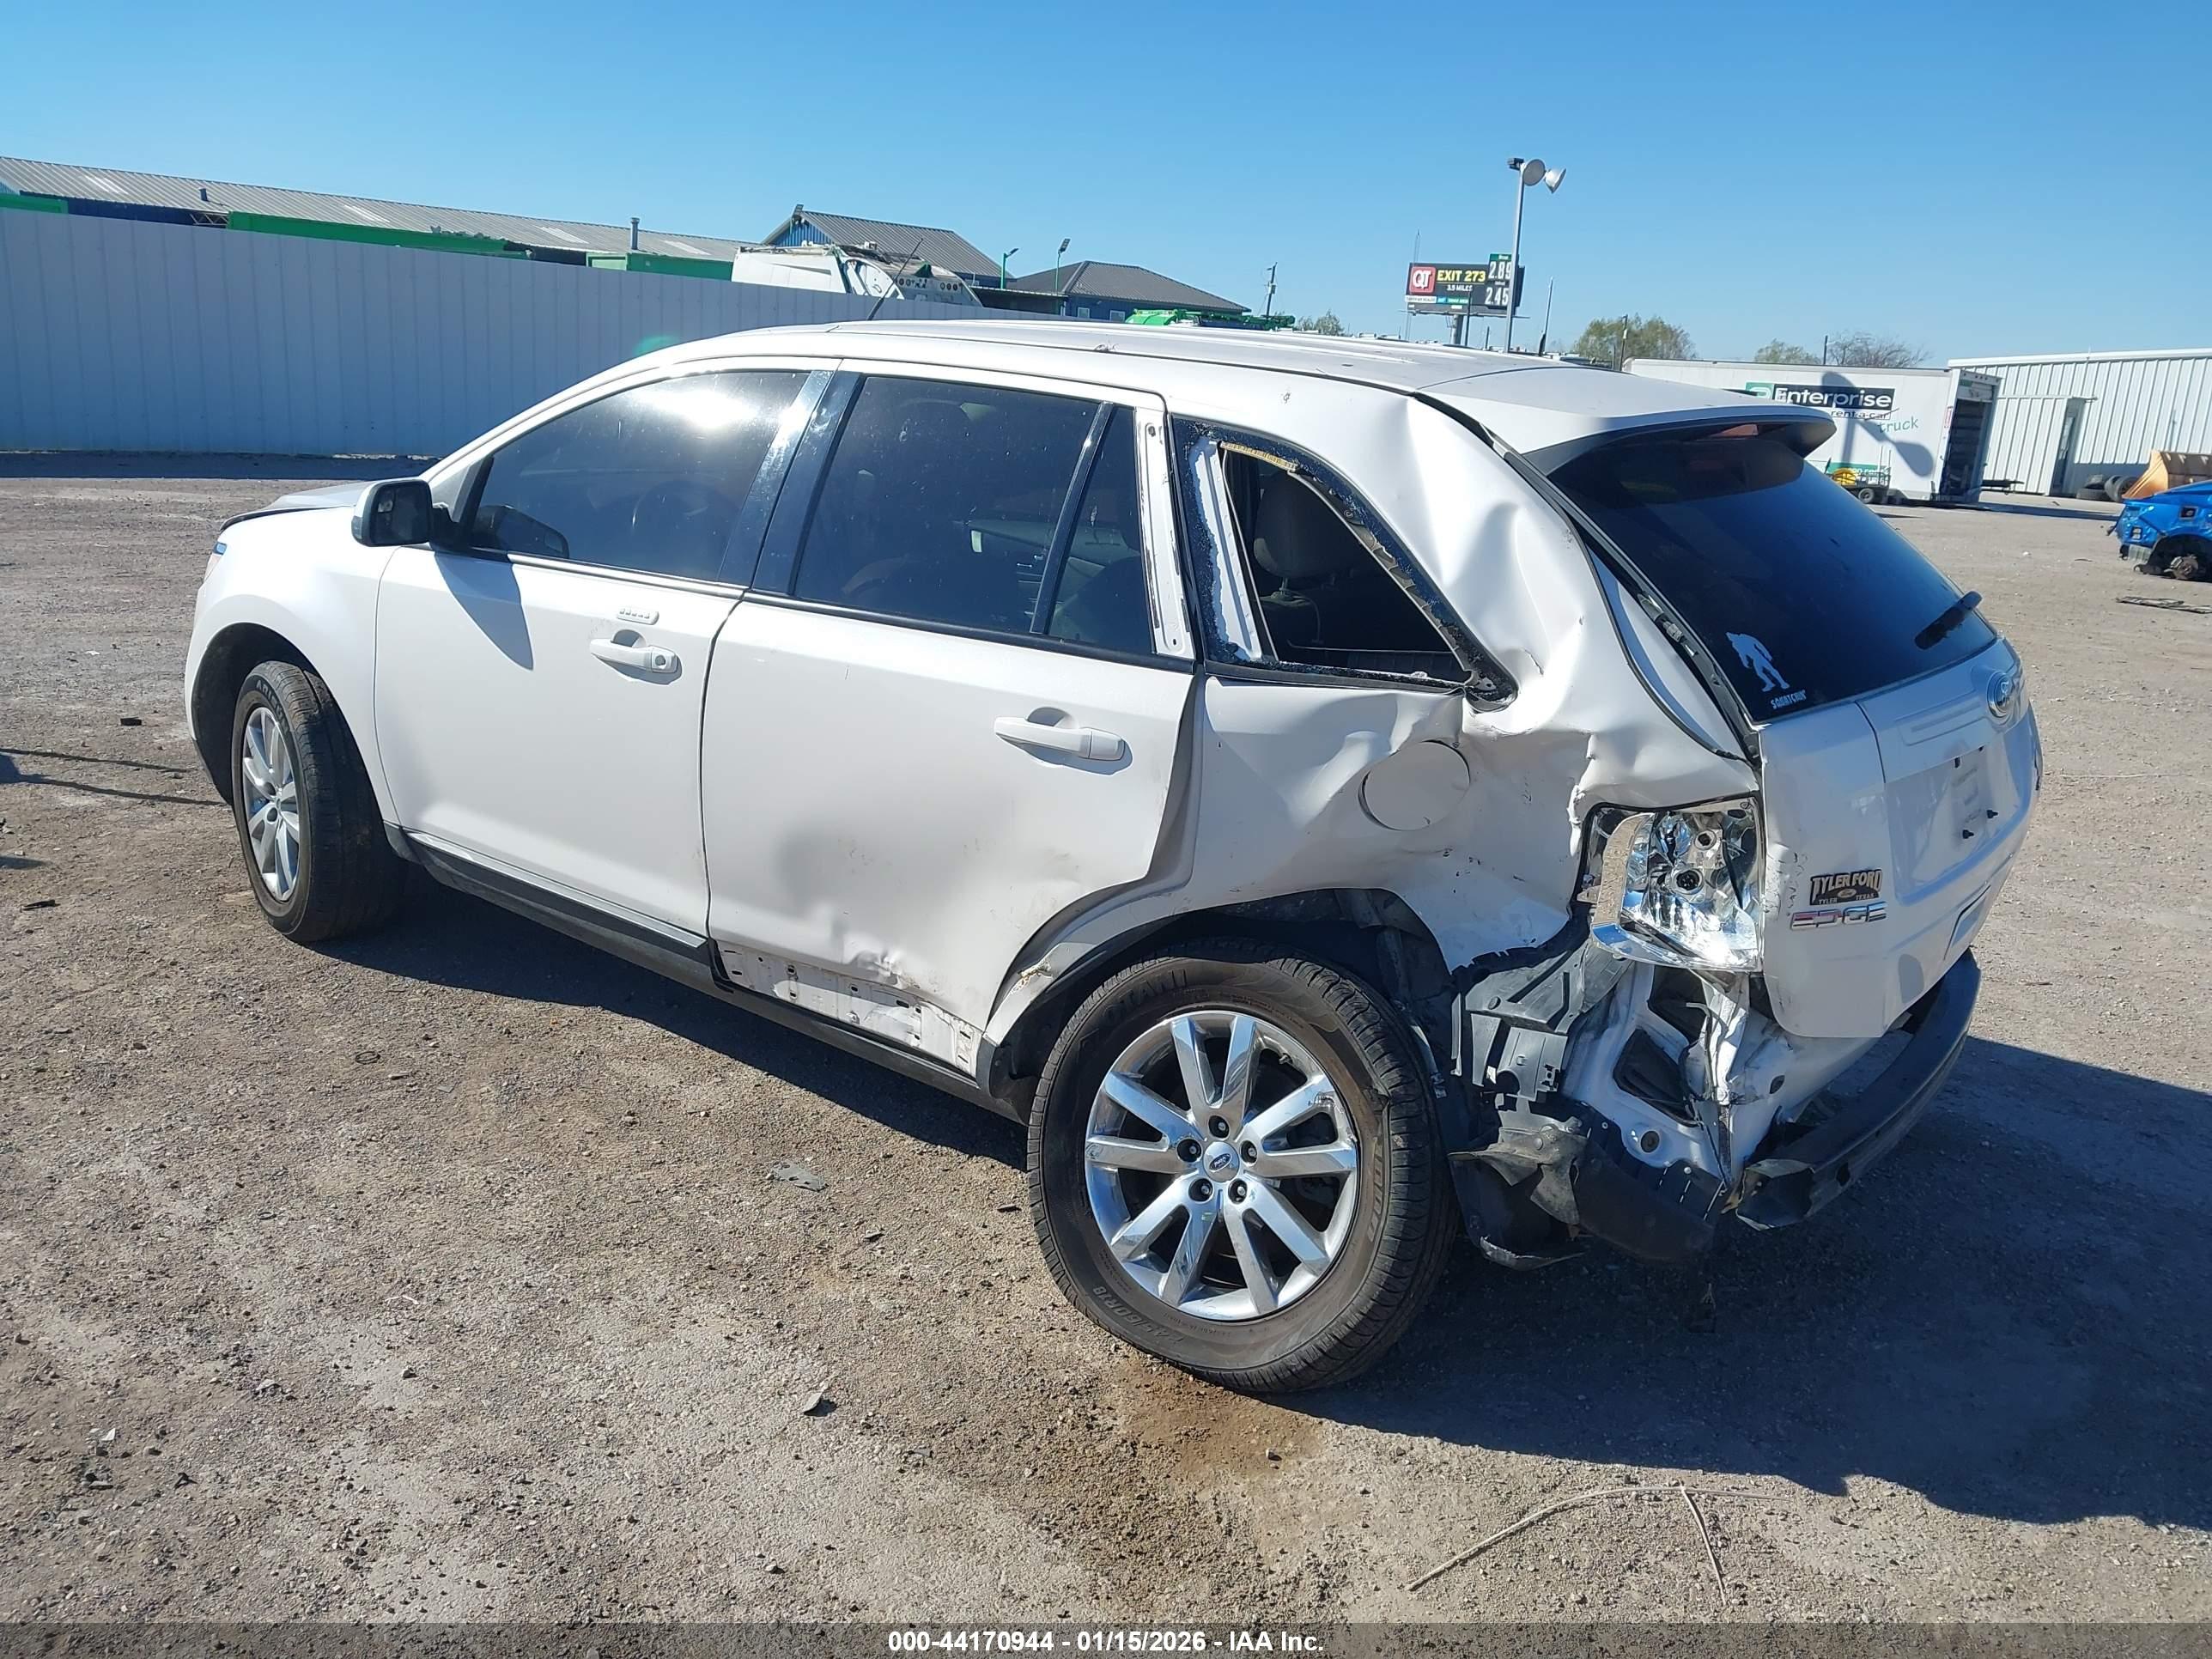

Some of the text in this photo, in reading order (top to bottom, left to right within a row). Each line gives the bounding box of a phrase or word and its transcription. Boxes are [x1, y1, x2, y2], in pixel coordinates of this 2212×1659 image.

[1413, 269, 1431, 289] QT
[1437, 270, 1463, 282] EXIT
[1463, 270, 1486, 283] 273
[1488, 261, 1512, 280] 2.89
[1455, 284, 1474, 293] MILES
[1484, 287, 1510, 306] 2.45
[1774, 387, 1892, 409] Enterprise
[1878, 416, 1919, 434] truck
[1811, 870, 1882, 903] TYLER FORD
[1790, 902, 1887, 931] EDGE
